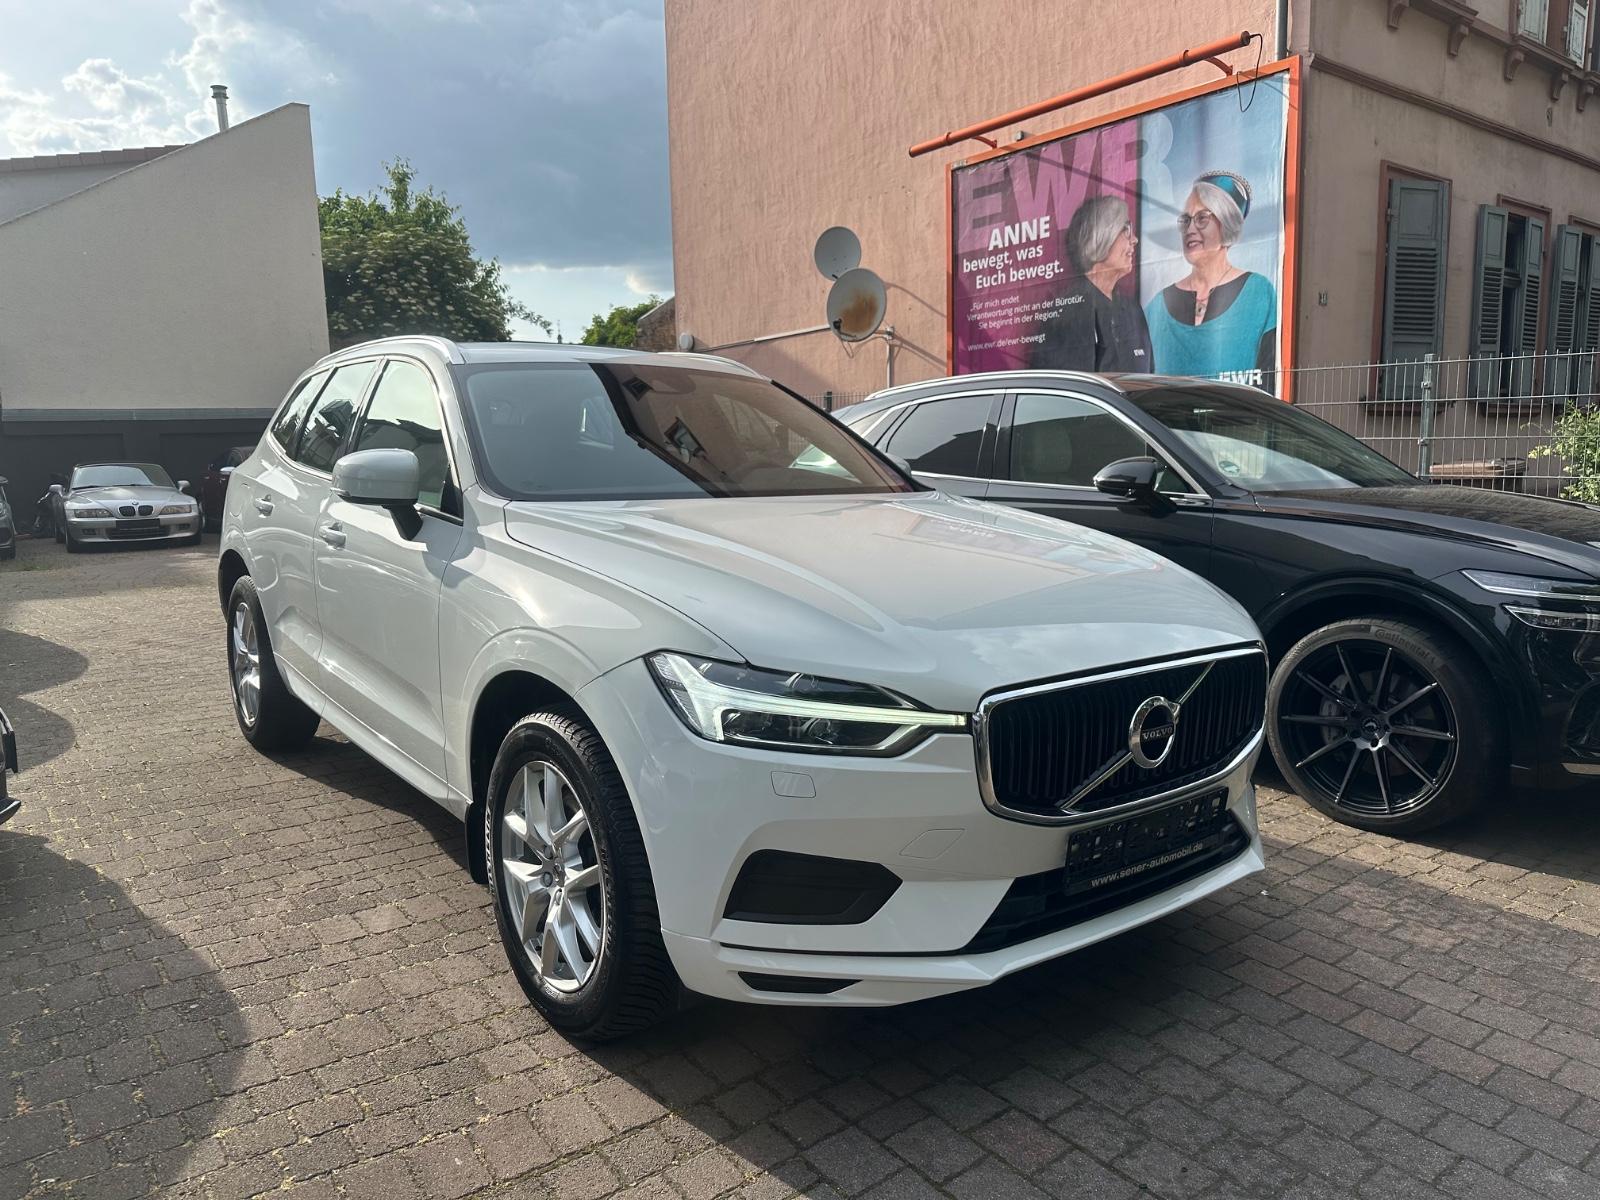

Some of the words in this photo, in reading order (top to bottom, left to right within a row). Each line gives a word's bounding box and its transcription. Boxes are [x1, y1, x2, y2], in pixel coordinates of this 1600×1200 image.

[988, 215, 1050, 251] ANNE
[963, 251, 1013, 273] bewegt,
[1016, 245, 1044, 262] was
[975, 270, 1006, 289] Euch
[1009, 259, 1064, 282] bewegt.
[966, 306, 1013, 322] Verantwortung
[1013, 304, 1031, 314] nicht
[1031, 301, 1041, 310] an
[1041, 299, 1054, 308] der
[1055, 294, 1086, 307] Bürotür.
[984, 299, 1000, 309] mich
[1001, 295, 1020, 306] endet
[978, 321, 988, 330] Sie
[988, 316, 1013, 330] beginnt
[1013, 314, 1021, 324] in
[1021, 312, 1033, 323] der
[967, 333, 1046, 352] www.ewr.de/ewr-bewegt
[1142, 726, 1173, 740] VOLVO
[1091, 842, 1203, 888] www.sener-automobil.de
